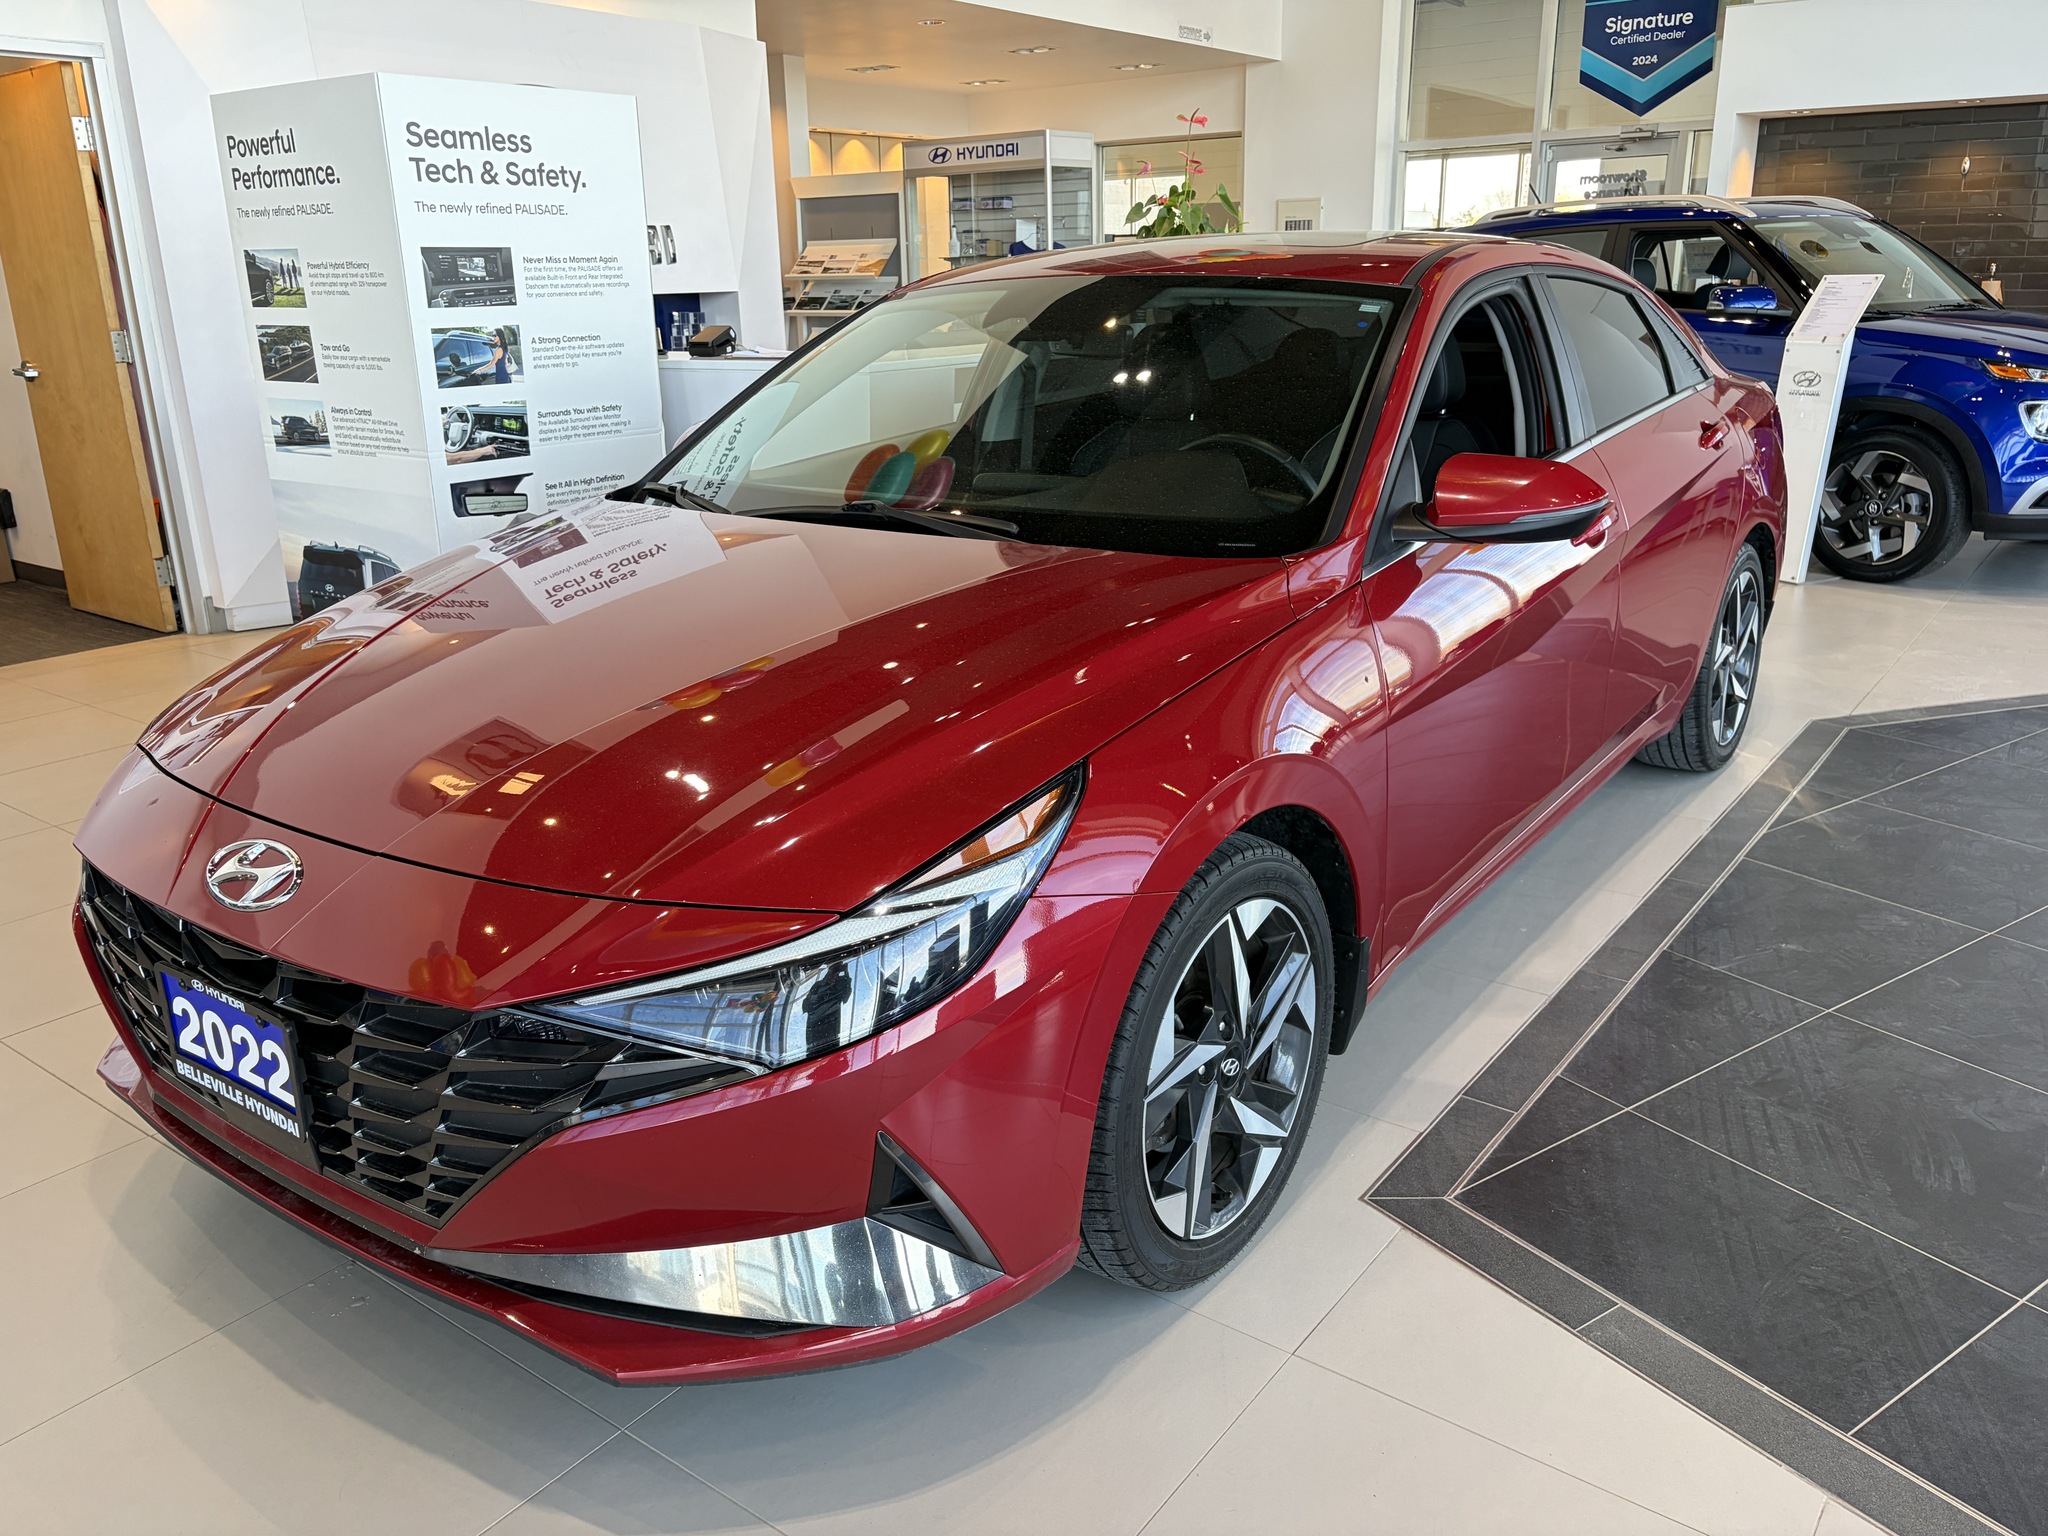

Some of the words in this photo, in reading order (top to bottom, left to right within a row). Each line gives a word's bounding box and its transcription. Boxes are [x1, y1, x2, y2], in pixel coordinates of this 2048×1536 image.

[1605, 12, 1694, 34] Signature
[1610, 33, 1651, 45] Certified
[1654, 30, 1686, 40] Dealer
[1632, 55, 1658, 65] 2024
[227, 128, 296, 158] Powerful
[406, 121, 532, 153] Seamless
[957, 143, 1018, 160] HYUNDAI
[232, 165, 340, 190] Performance.
[409, 157, 473, 183] Tech
[481, 161, 499, 185] &
[505, 162, 586, 193] Safety.
[237, 208, 250, 218] The
[251, 207, 270, 219] newly
[272, 205, 295, 216] refined
[297, 203, 333, 215] PALISADE.
[414, 201, 436, 212] The
[440, 203, 472, 215] newly
[476, 203, 512, 214] refined
[515, 204, 568, 215] PALISADE.
[329, 261, 344, 270] Hybrid
[346, 261, 369, 270] Efficiency
[599, 255, 618, 264] Again
[562, 334, 601, 343] Connection
[331, 406, 348, 415] Always
[354, 408, 372, 416] Control
[538, 409, 571, 419] Surrounds
[602, 404, 622, 412] Safety
[580, 477, 595, 486] High
[596, 474, 625, 483] Definition
[206, 986, 245, 1012] HYUNDAI
[173, 996, 295, 1107] 2022
[176, 1059, 244, 1106] BELLEVILLE
[245, 1094, 300, 1138] HYUNDAI
